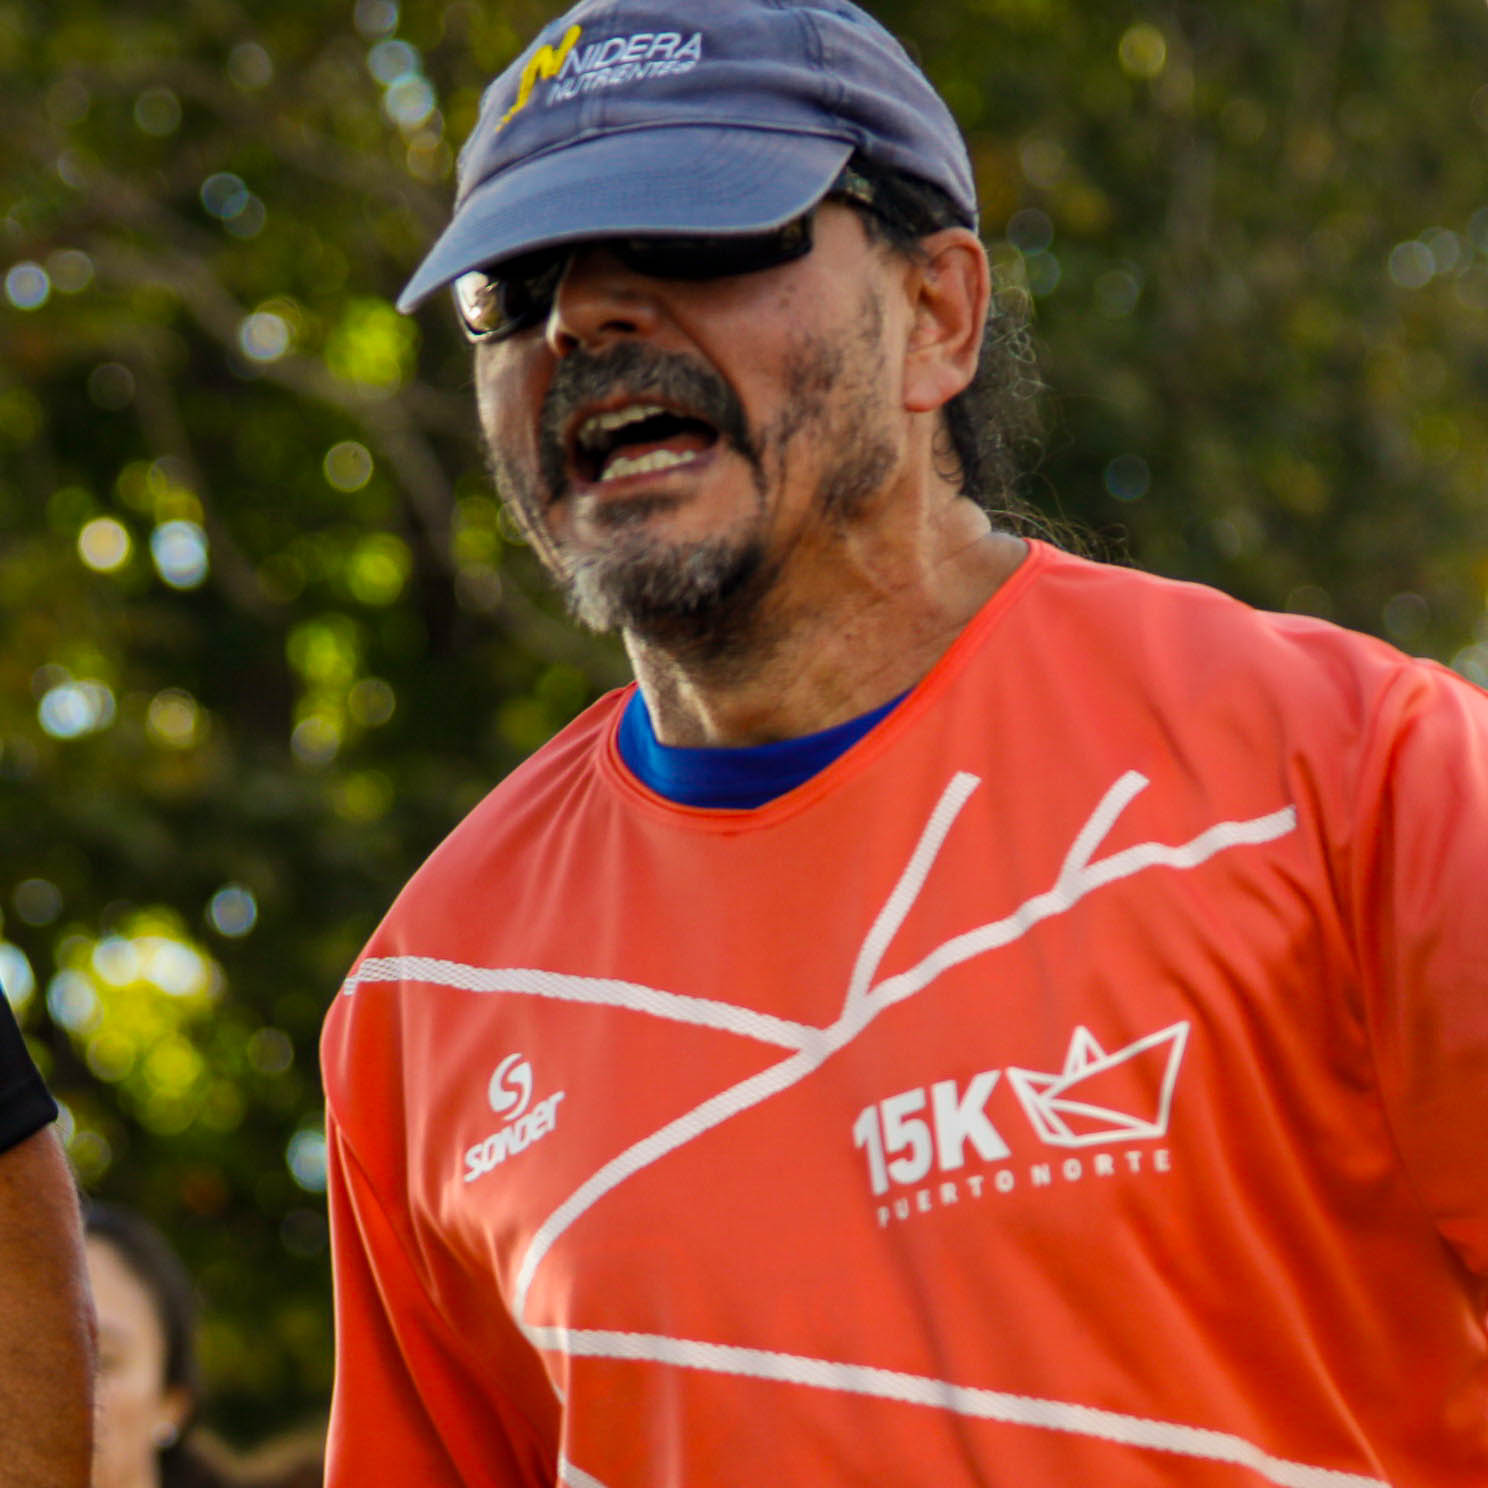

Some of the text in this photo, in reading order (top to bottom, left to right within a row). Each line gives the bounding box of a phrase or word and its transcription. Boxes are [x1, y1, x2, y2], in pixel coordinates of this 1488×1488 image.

[559, 31, 703, 78] NIDERA
[852, 1069, 1012, 1197] 15K
[876, 1148, 1172, 1229] PUERTO NORTE
